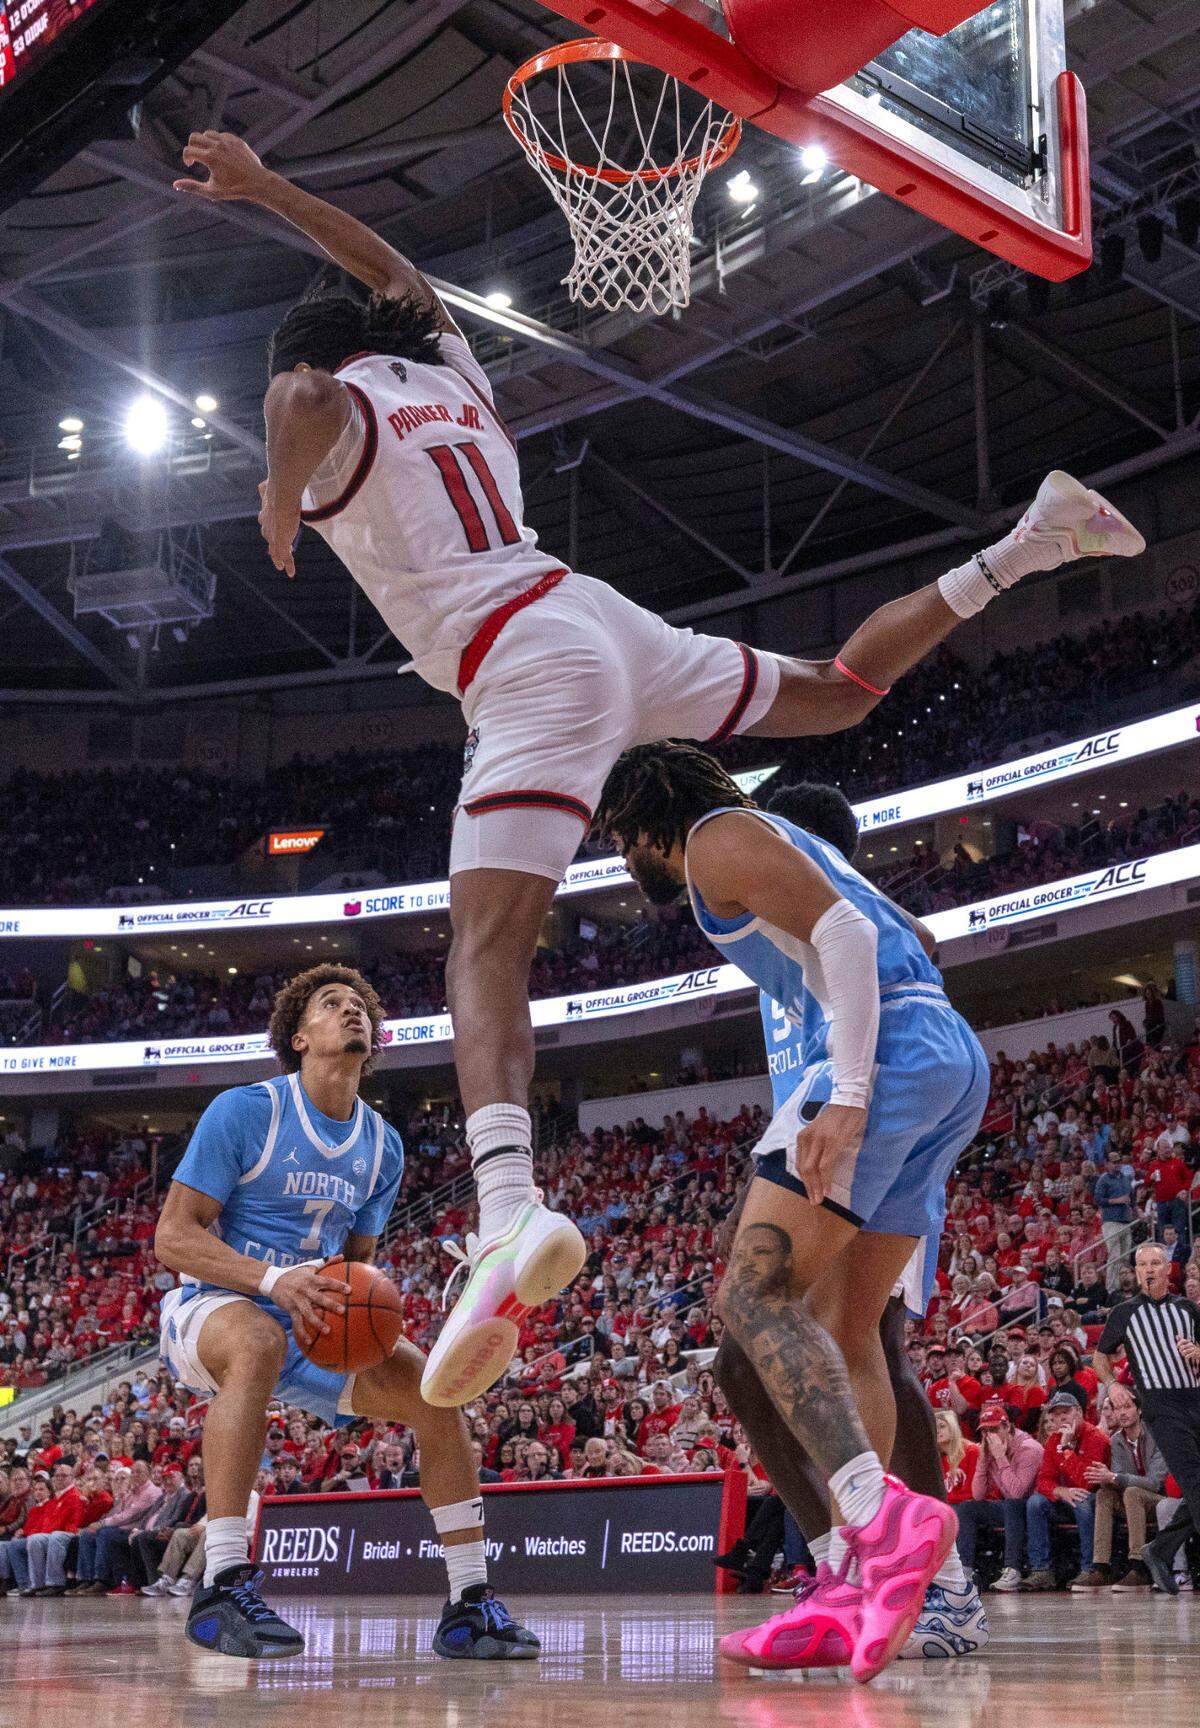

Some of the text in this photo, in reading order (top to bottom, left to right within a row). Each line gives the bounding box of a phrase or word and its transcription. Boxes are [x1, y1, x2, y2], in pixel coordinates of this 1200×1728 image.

[387, 403, 485, 441] PARKER JR.
[422, 441, 522, 554] 11
[986, 770, 1022, 788] OFFICIAL
[1023, 758, 1058, 777] GROCER
[1076, 732, 1121, 760] ACC
[855, 805, 902, 829] VE MORE
[569, 868, 604, 881] OFFICIAL
[989, 899, 1030, 918] OFFICIAL
[1033, 886, 1073, 906] GROCER
[1094, 858, 1149, 890] ACC
[137, 912, 175, 922] OFFICIAL
[176, 910, 210, 920] GROCER
[229, 901, 274, 917] ACC
[365, 894, 405, 913] SCORE
[410, 895, 423, 908] TO
[585, 968, 721, 1009] OFFICIAL GROCER ACC
[397, 1025, 451, 1041] SCORE TO
[4, 1055, 77, 1069] TO GIVE MORE
[164, 1045, 206, 1056] OFFICIAL
[208, 1042, 245, 1053] GROCER
[282, 1171, 356, 1207] NORTH
[300, 1199, 335, 1250] 7
[260, 1526, 341, 1564] REEDS
[362, 1540, 401, 1560] Bridal
[485, 1538, 504, 1561] lry
[525, 1536, 587, 1556] Watches
[620, 1531, 714, 1553] REEDS.com
[271, 1567, 320, 1578] JEWELERS
